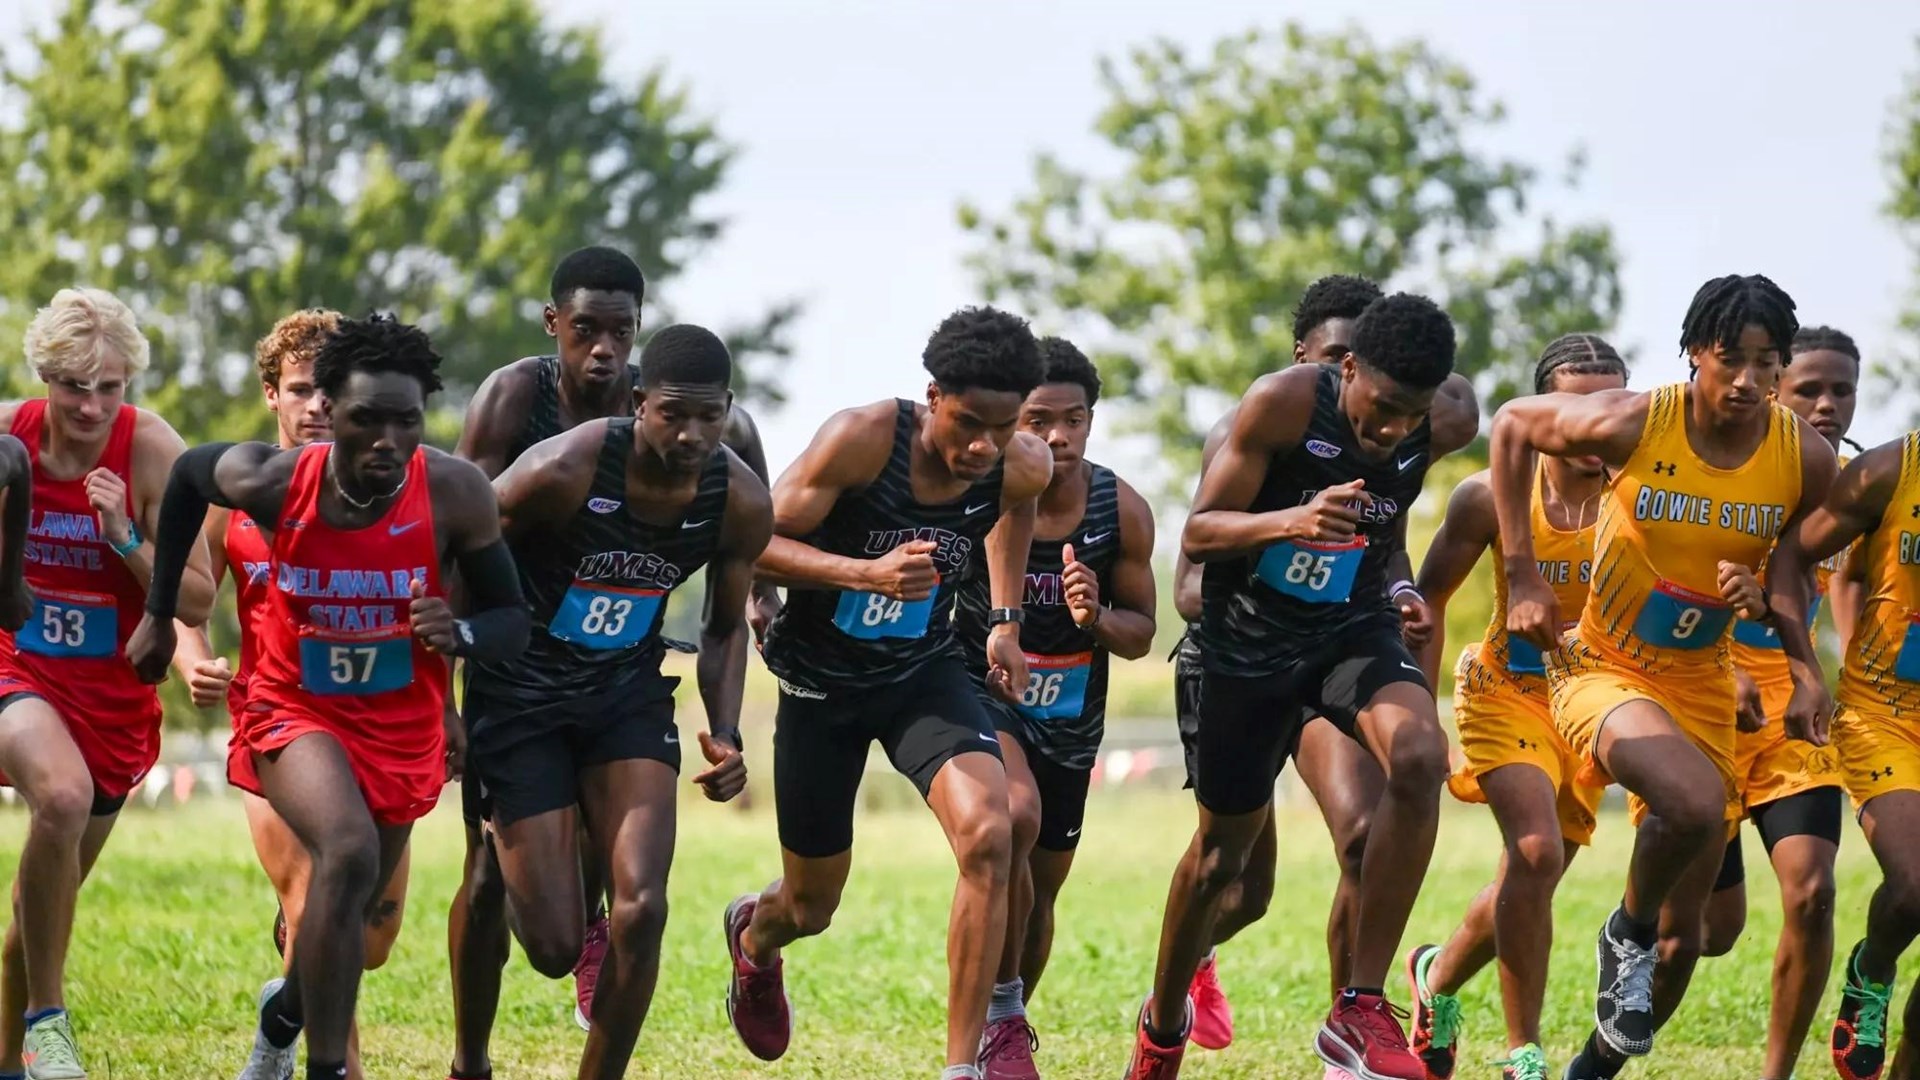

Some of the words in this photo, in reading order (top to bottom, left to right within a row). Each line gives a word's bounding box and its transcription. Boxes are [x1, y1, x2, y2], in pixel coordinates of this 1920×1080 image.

[27, 509, 107, 542] LAWA
[1634, 484, 1713, 526] BOWIE
[1719, 501, 1785, 540] STATE
[24, 540, 103, 571] STATE
[575, 551, 681, 589] UMES
[1285, 551, 1336, 591] 85
[277, 562, 428, 598] DELAWARE
[43, 604, 86, 647] 53
[308, 604, 397, 632] STATE
[582, 595, 632, 636] 83
[862, 592, 904, 626] 84
[1671, 607, 1703, 639] 9
[330, 646, 378, 684] 57
